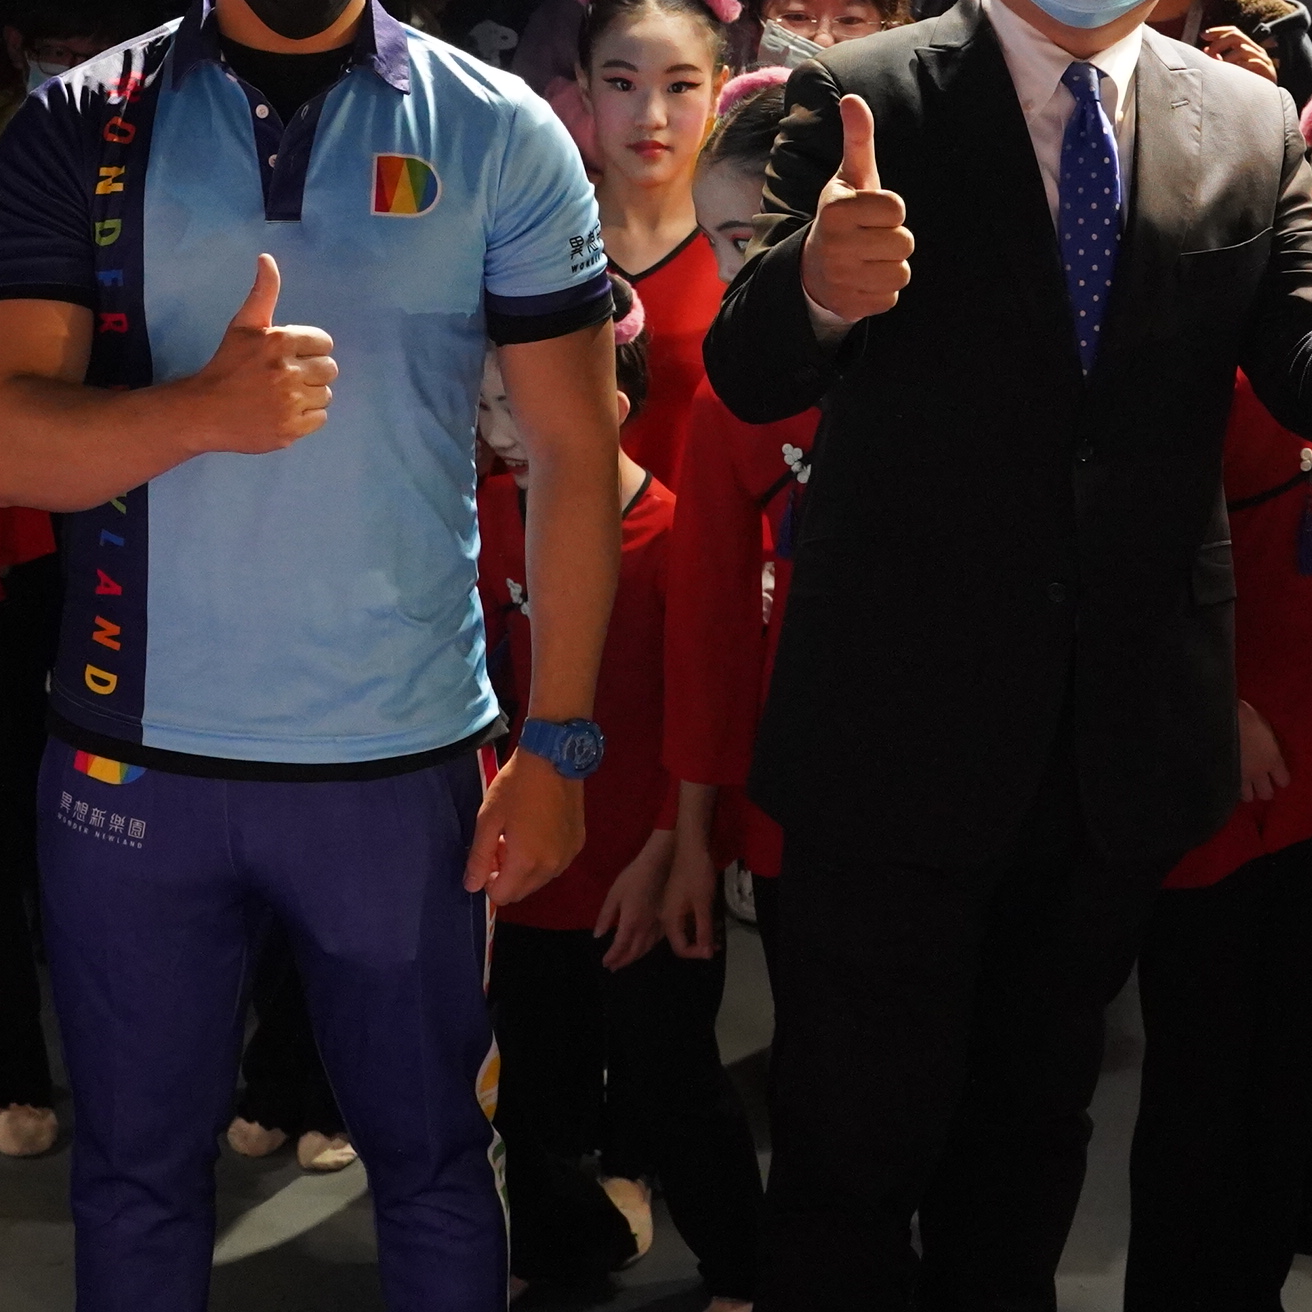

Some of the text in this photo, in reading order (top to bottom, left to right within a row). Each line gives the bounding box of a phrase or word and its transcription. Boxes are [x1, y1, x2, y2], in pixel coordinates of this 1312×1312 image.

[57, 812, 143, 849] WONDER NEWLAND
[59, 790, 146, 839] 異想新樂園
